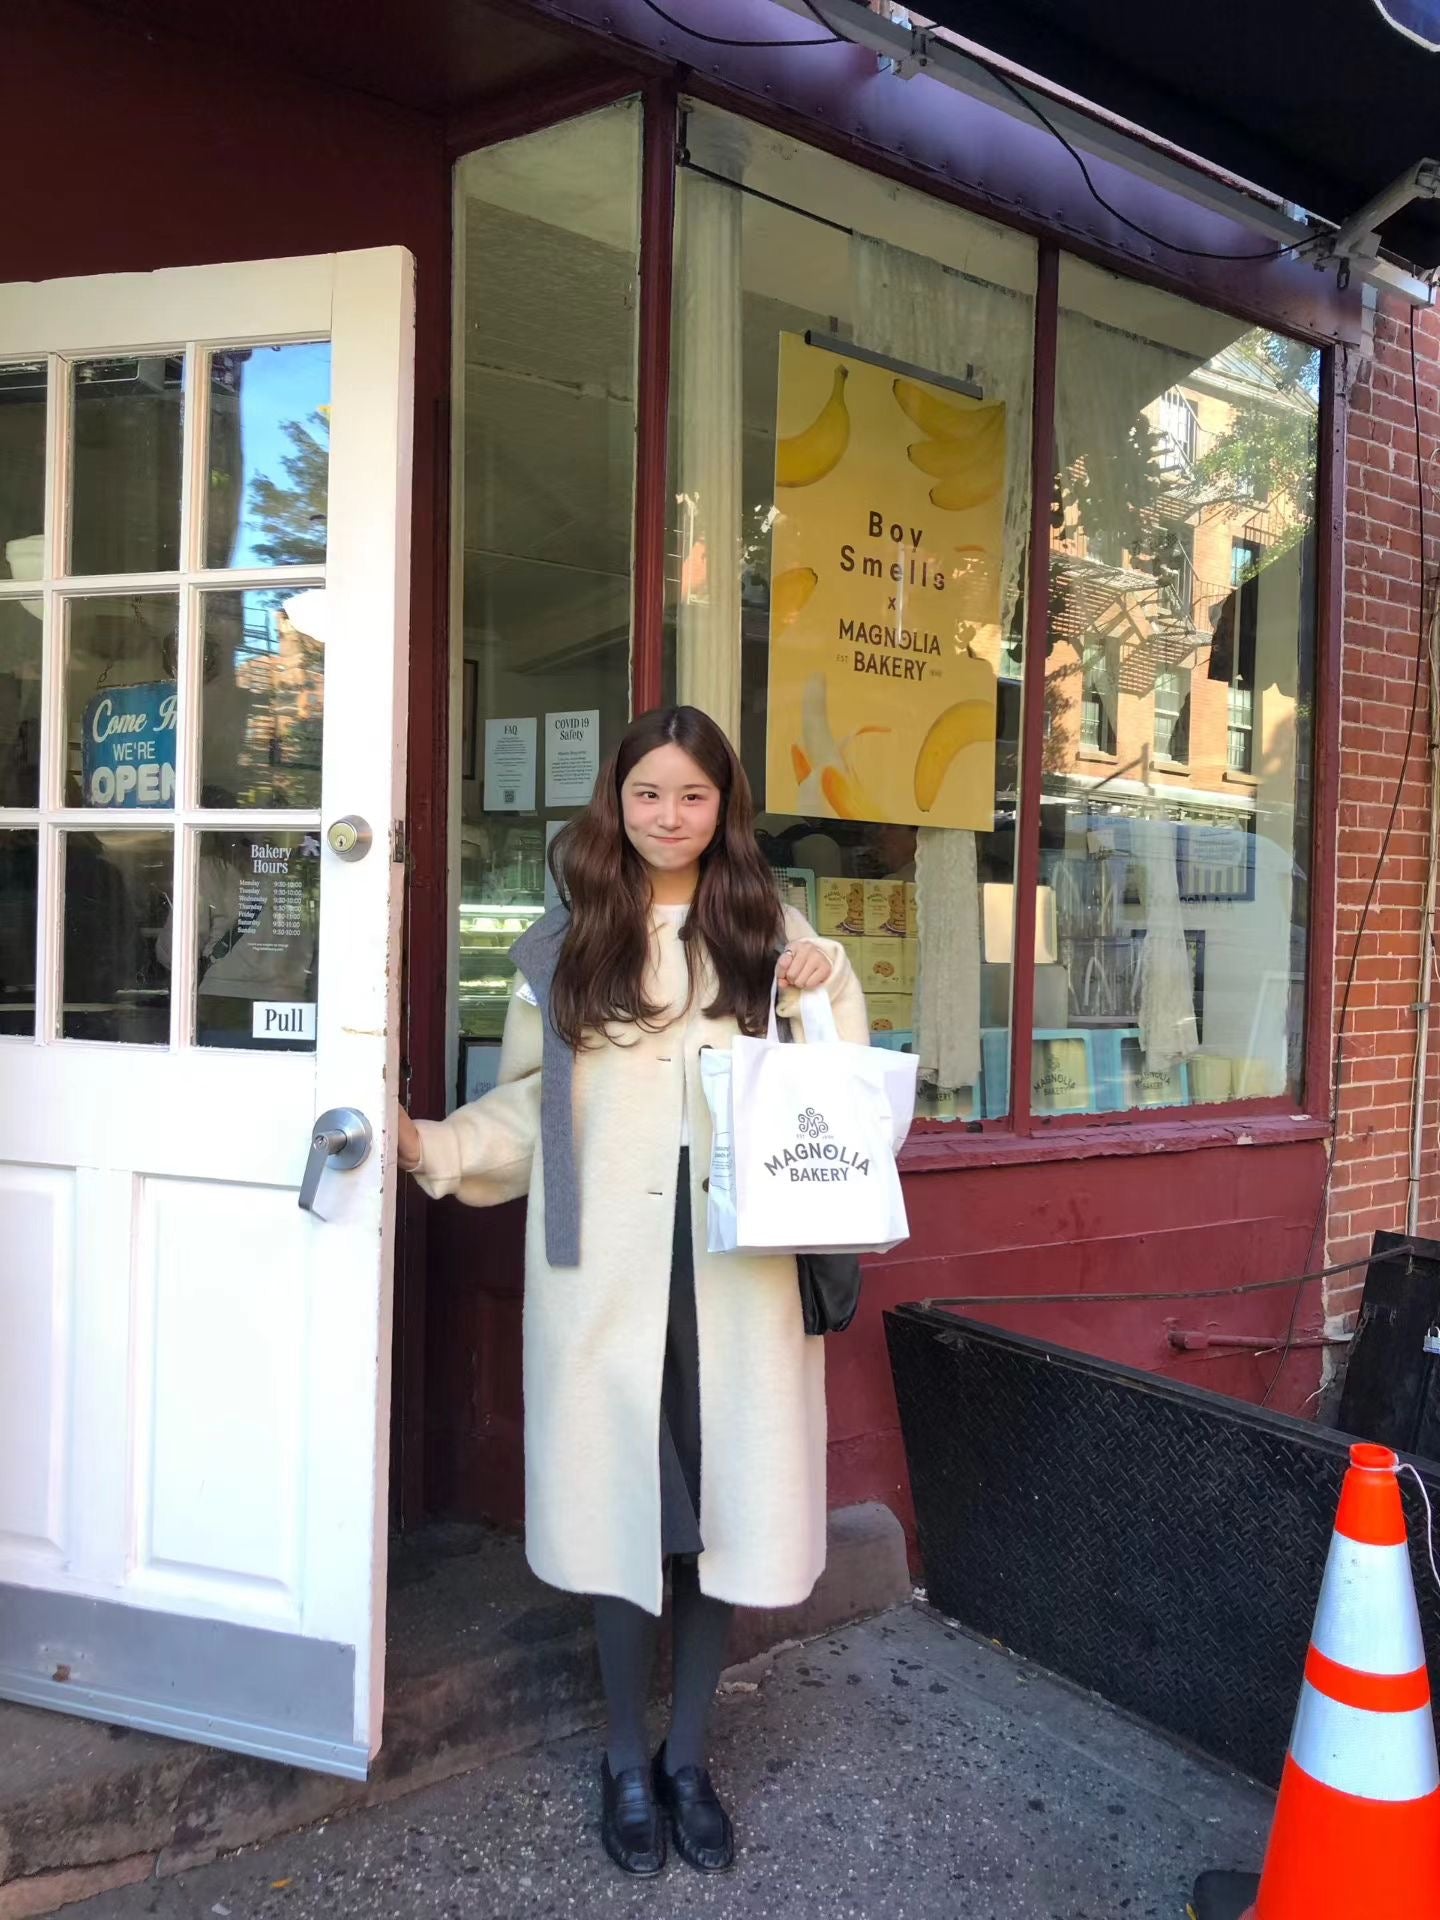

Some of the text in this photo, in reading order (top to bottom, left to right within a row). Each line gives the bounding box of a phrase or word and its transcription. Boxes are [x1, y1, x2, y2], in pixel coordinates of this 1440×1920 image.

[868, 510, 923, 553] Boy
[839, 544, 945, 591] Smells
[838, 618, 942, 656] MAGNOLIA
[853, 650, 928, 682] BAKERY
[92, 699, 148, 743] Come
[504, 725, 518, 736] FAQ
[554, 717, 590, 730] COVID 19
[559, 730, 584, 741] Safety
[112, 740, 156, 761] WE'RE
[91, 762, 176, 804] OPEN
[251, 844, 292, 861] Bakery
[253, 860, 289, 874] Hours
[264, 1008, 304, 1033] Pull
[763, 1142, 870, 1176] MAGNOLIA
[789, 1167, 849, 1182] BAKERY
